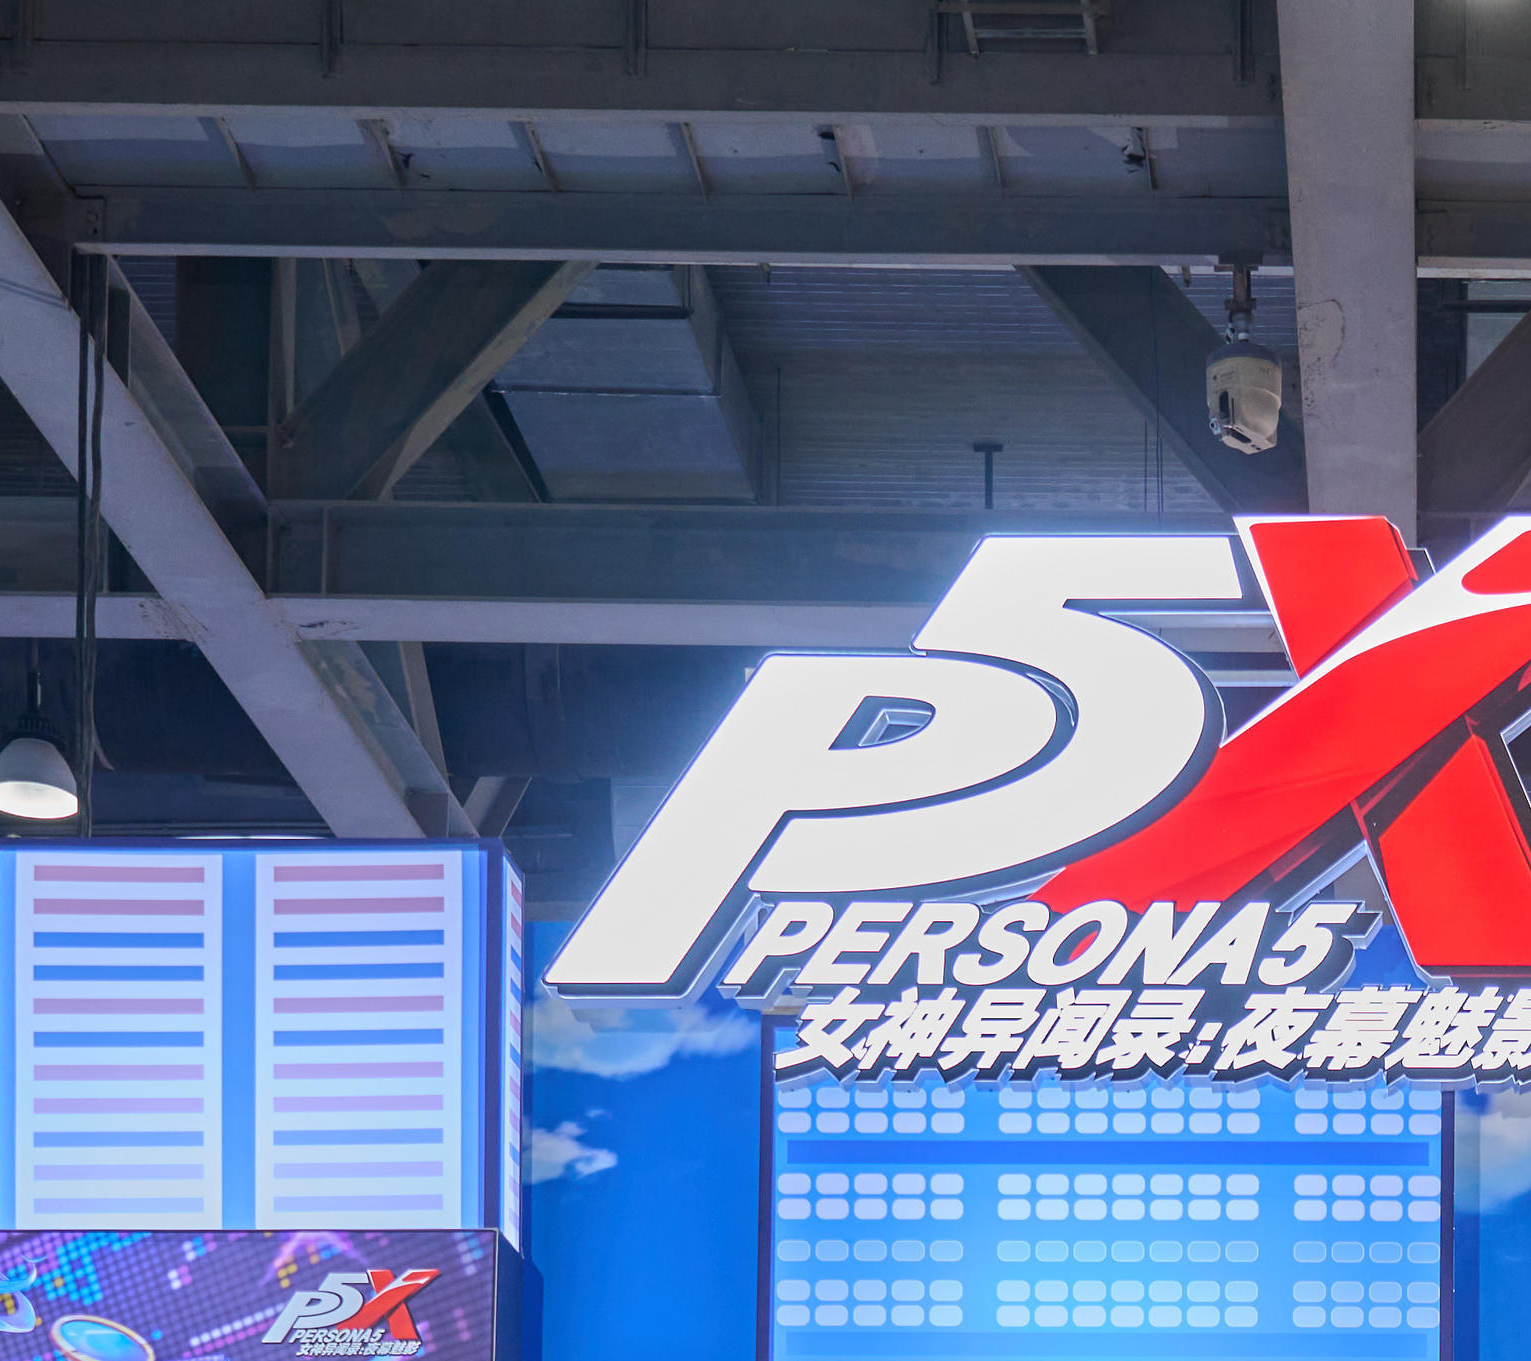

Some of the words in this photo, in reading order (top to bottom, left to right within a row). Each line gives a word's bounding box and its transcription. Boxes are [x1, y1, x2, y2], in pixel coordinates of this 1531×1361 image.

[729, 902, 1365, 986] PERSONA5
[261, 1268, 441, 1344] P5X
[289, 1328, 385, 1344] PERSONA5
